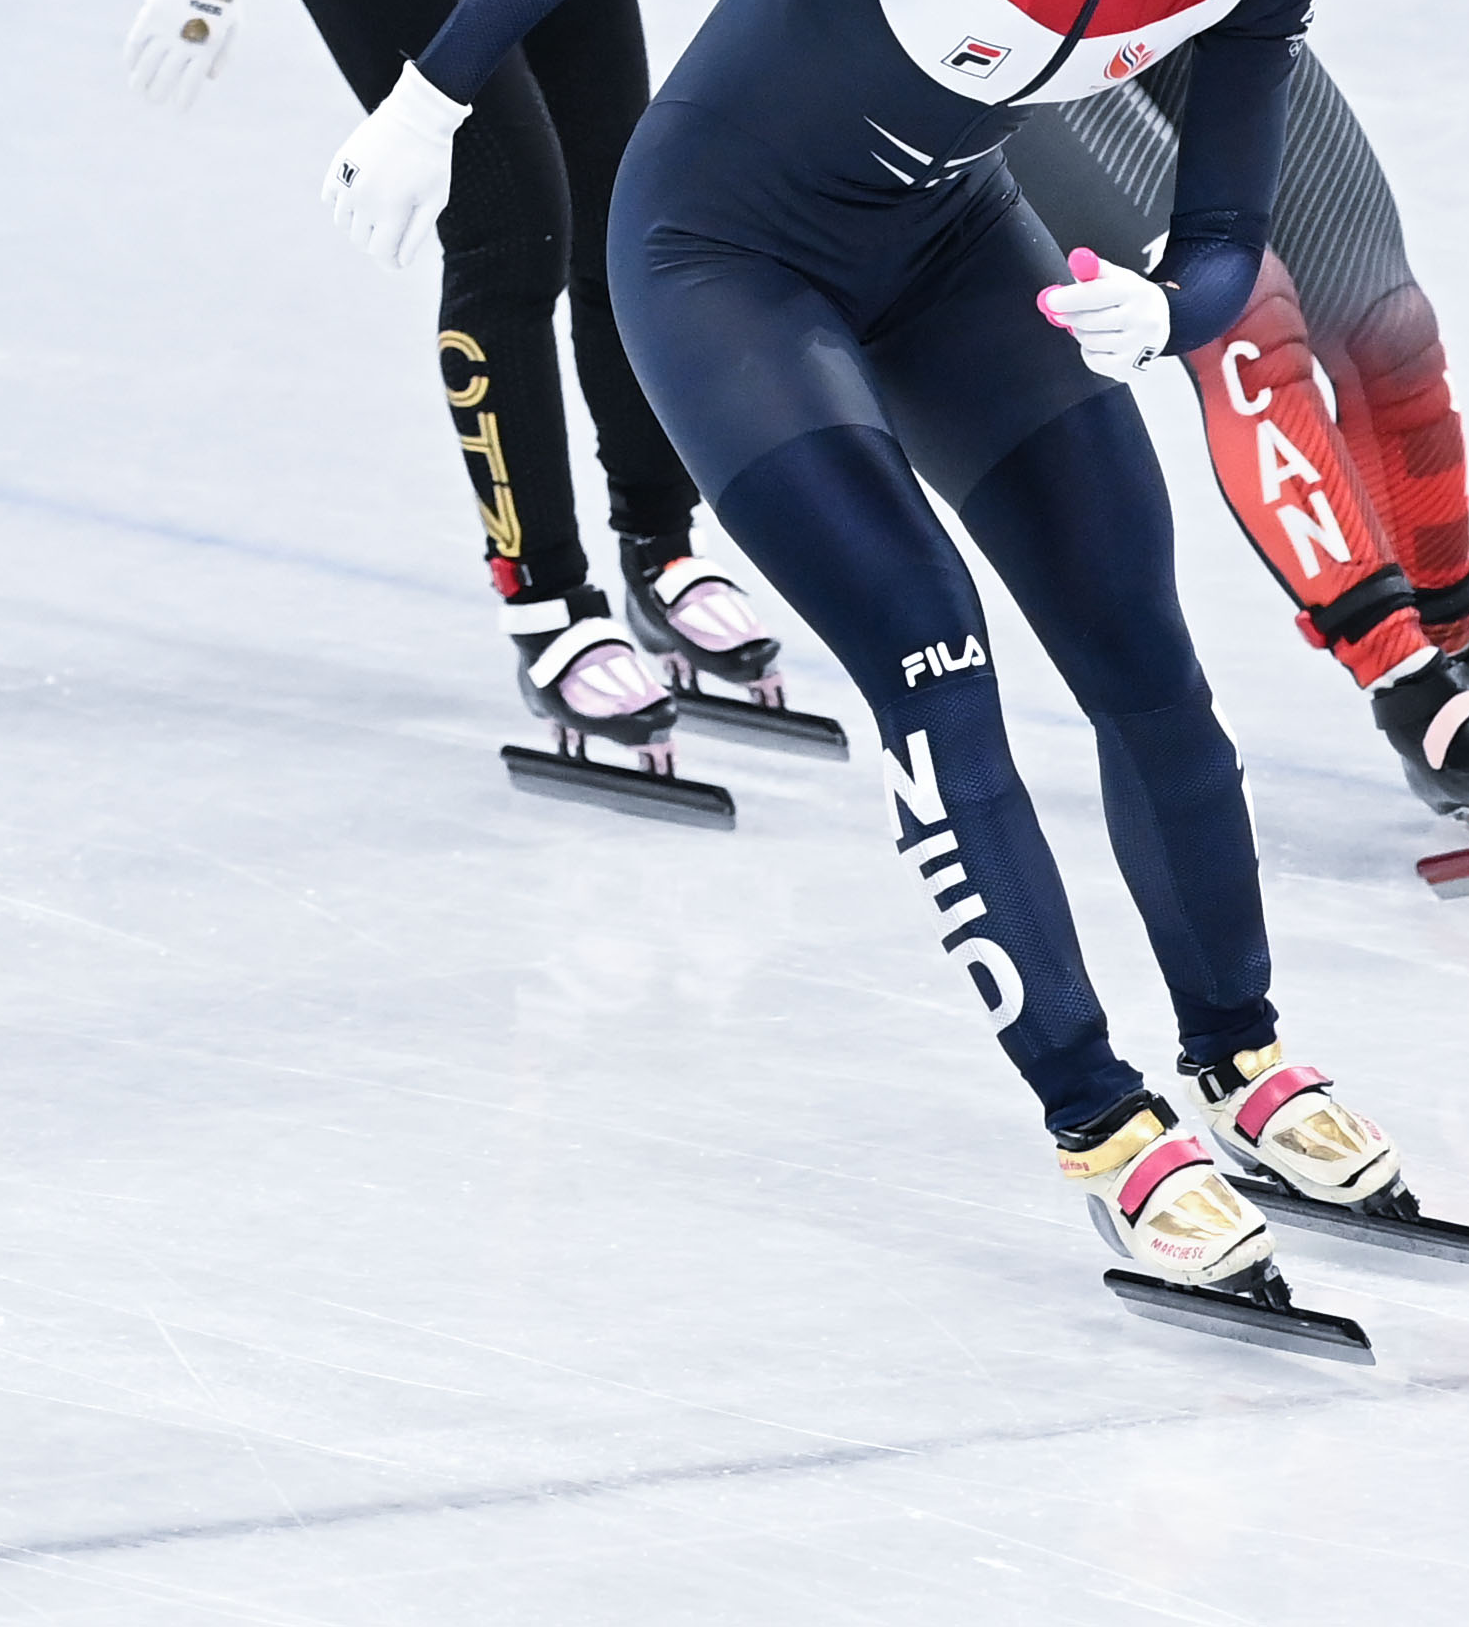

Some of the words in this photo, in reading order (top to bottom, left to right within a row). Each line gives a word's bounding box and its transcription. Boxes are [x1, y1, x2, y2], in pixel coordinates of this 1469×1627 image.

[1221, 340, 1352, 580] CAN
[901, 634, 987, 688] FILA
[882, 728, 1025, 1037] NED
[1149, 1236, 1207, 1260] MARCHESE
